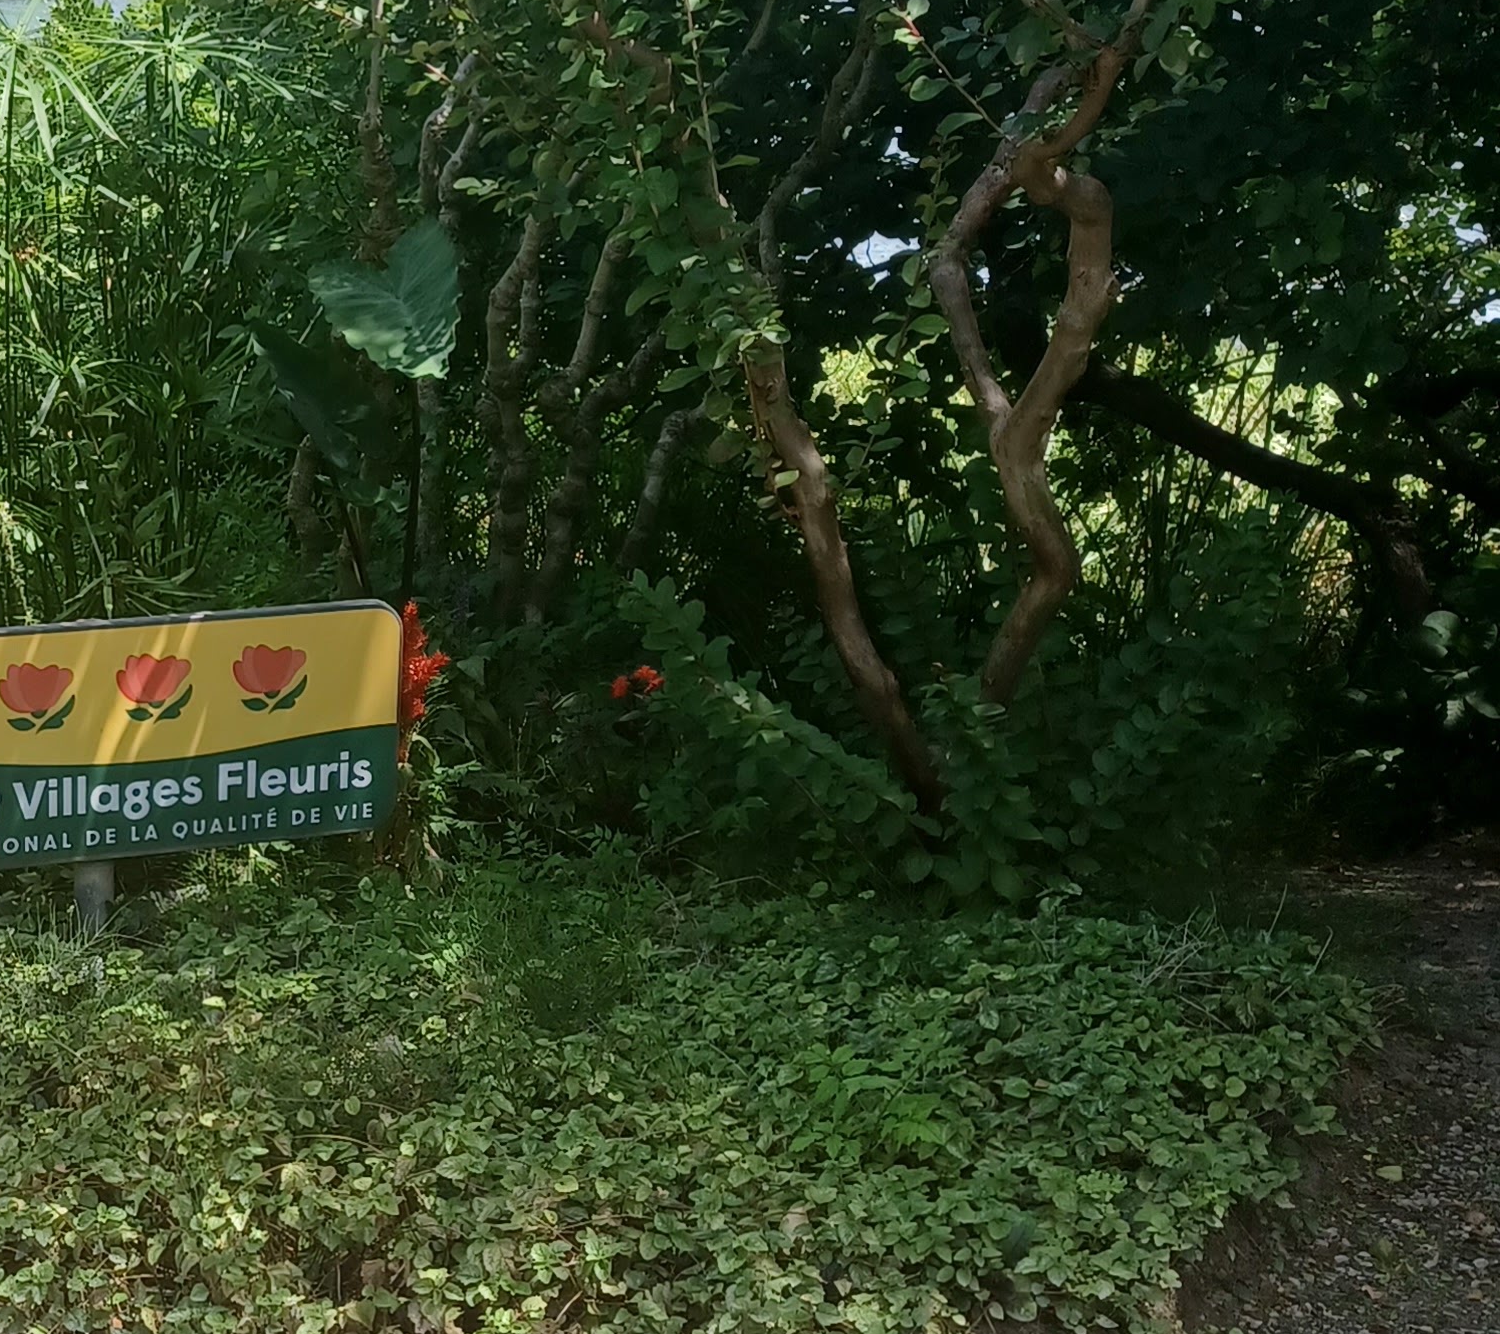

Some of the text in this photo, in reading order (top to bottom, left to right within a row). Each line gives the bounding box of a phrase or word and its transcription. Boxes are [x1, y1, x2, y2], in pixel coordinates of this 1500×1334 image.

[12, 775, 203, 820] Villages
[217, 751, 373, 802] Fleuris
[85, 828, 117, 847] DE
[131, 824, 158, 842] LA
[172, 807, 277, 839] QUALITÉ
[291, 807, 321, 826] DE
[335, 802, 373, 821] VIE
